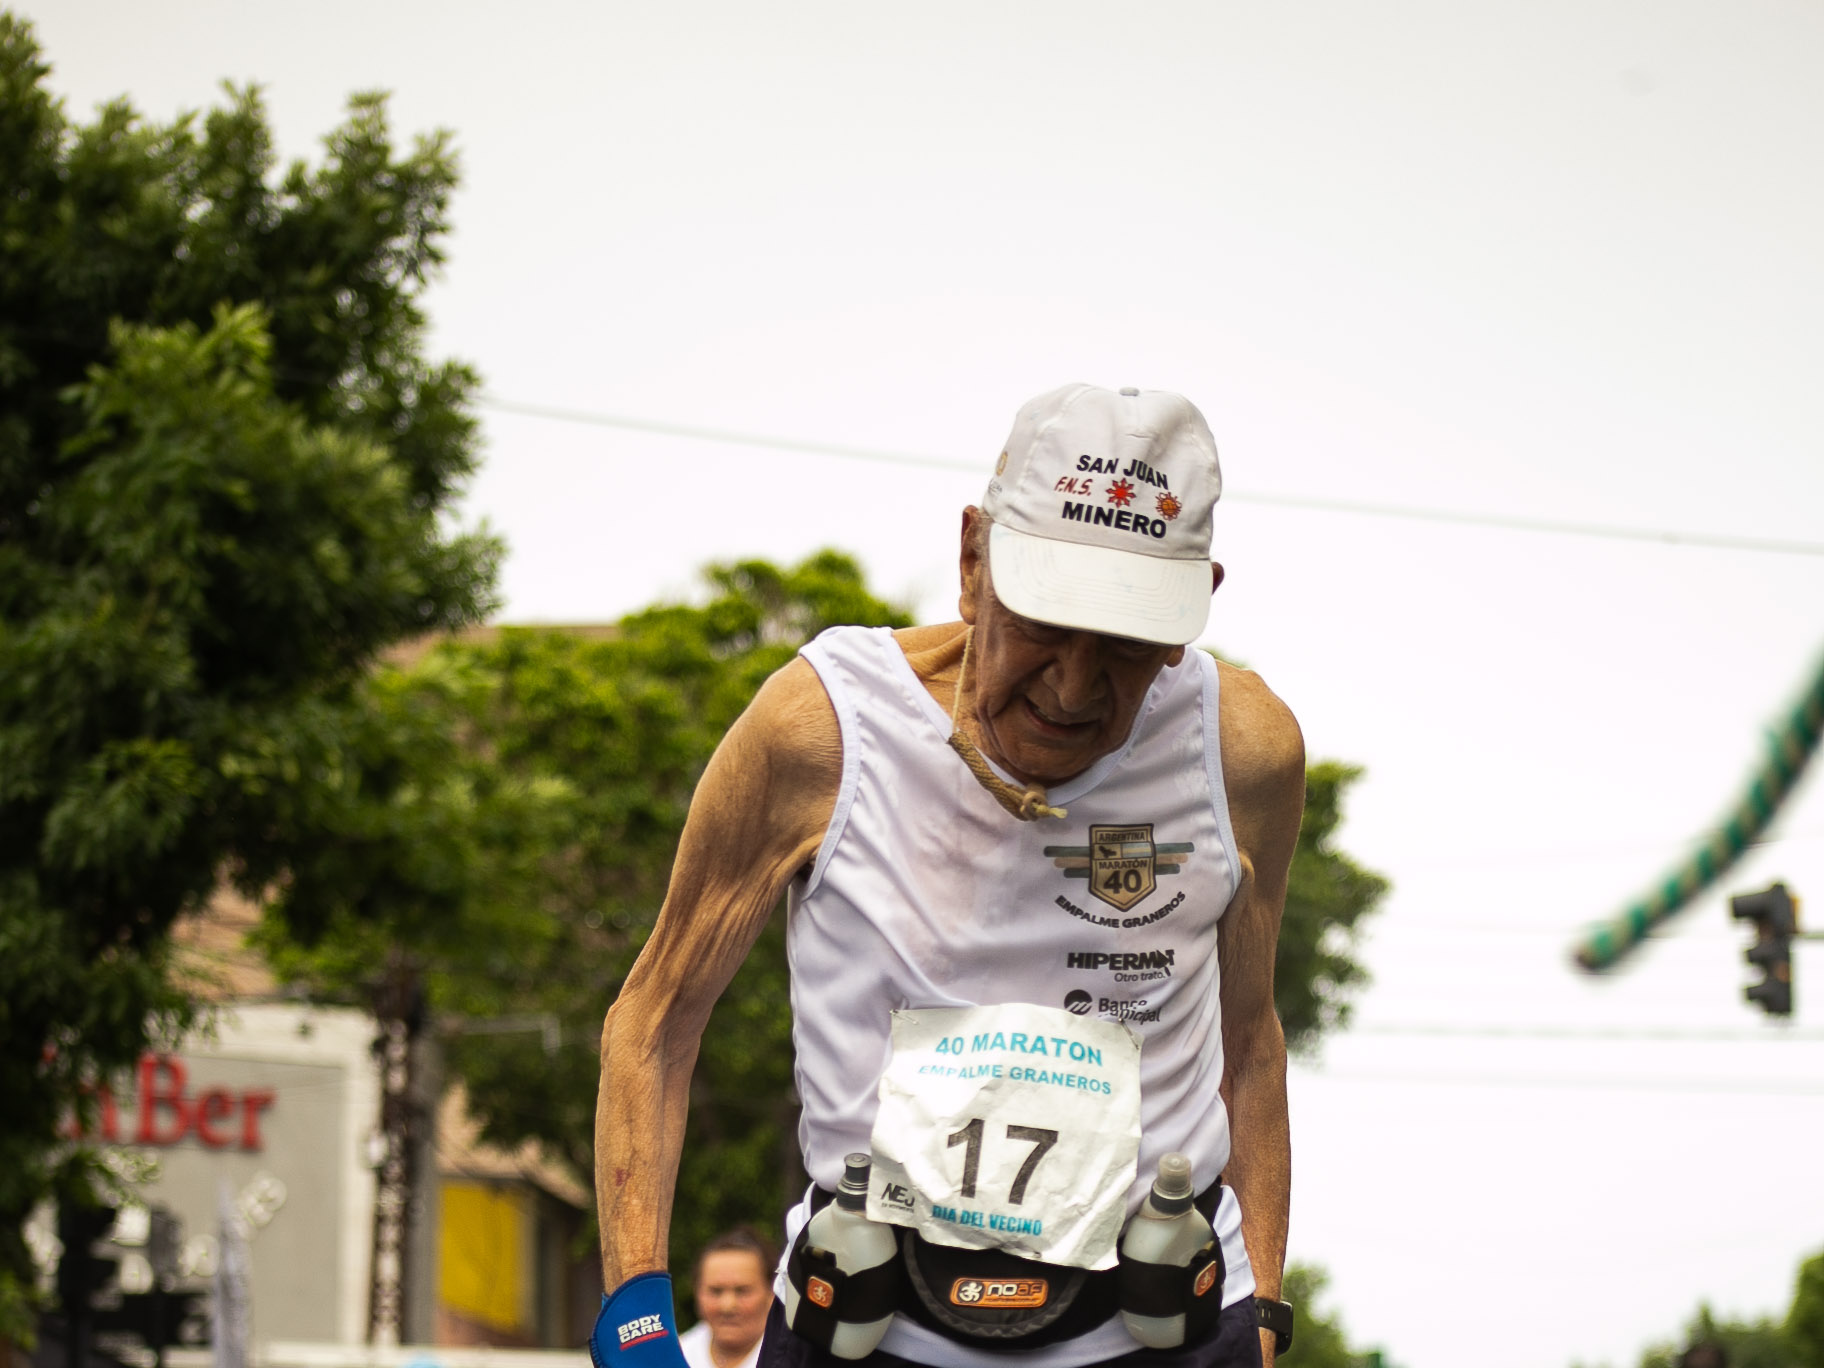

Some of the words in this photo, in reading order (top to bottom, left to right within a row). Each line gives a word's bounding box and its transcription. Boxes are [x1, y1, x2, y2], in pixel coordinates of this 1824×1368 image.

[1076, 455, 1118, 474] SAN
[1123, 458, 1168, 490] JUAN
[1061, 501, 1167, 539] MINERO
[1098, 831, 1145, 842] ARGENTINA
[1098, 859, 1148, 870] MARATÓN
[1103, 869, 1143, 894] 40
[1055, 895, 1120, 928] EMPALME
[1122, 891, 1186, 928] GRANEROS
[1114, 972, 1139, 982] Otro
[935, 1036, 964, 1056] 40
[971, 1032, 1103, 1067] MARATON
[918, 1064, 1003, 1080] EMPALME
[1009, 1066, 1112, 1095] GRANEROS
[947, 1118, 1059, 1205] 17
[932, 1205, 957, 1223] DIA
[960, 1210, 985, 1229] DEL
[989, 1214, 1043, 1236] VECINO
[617, 1314, 661, 1336] BODY
[619, 1322, 665, 1344] CARE
